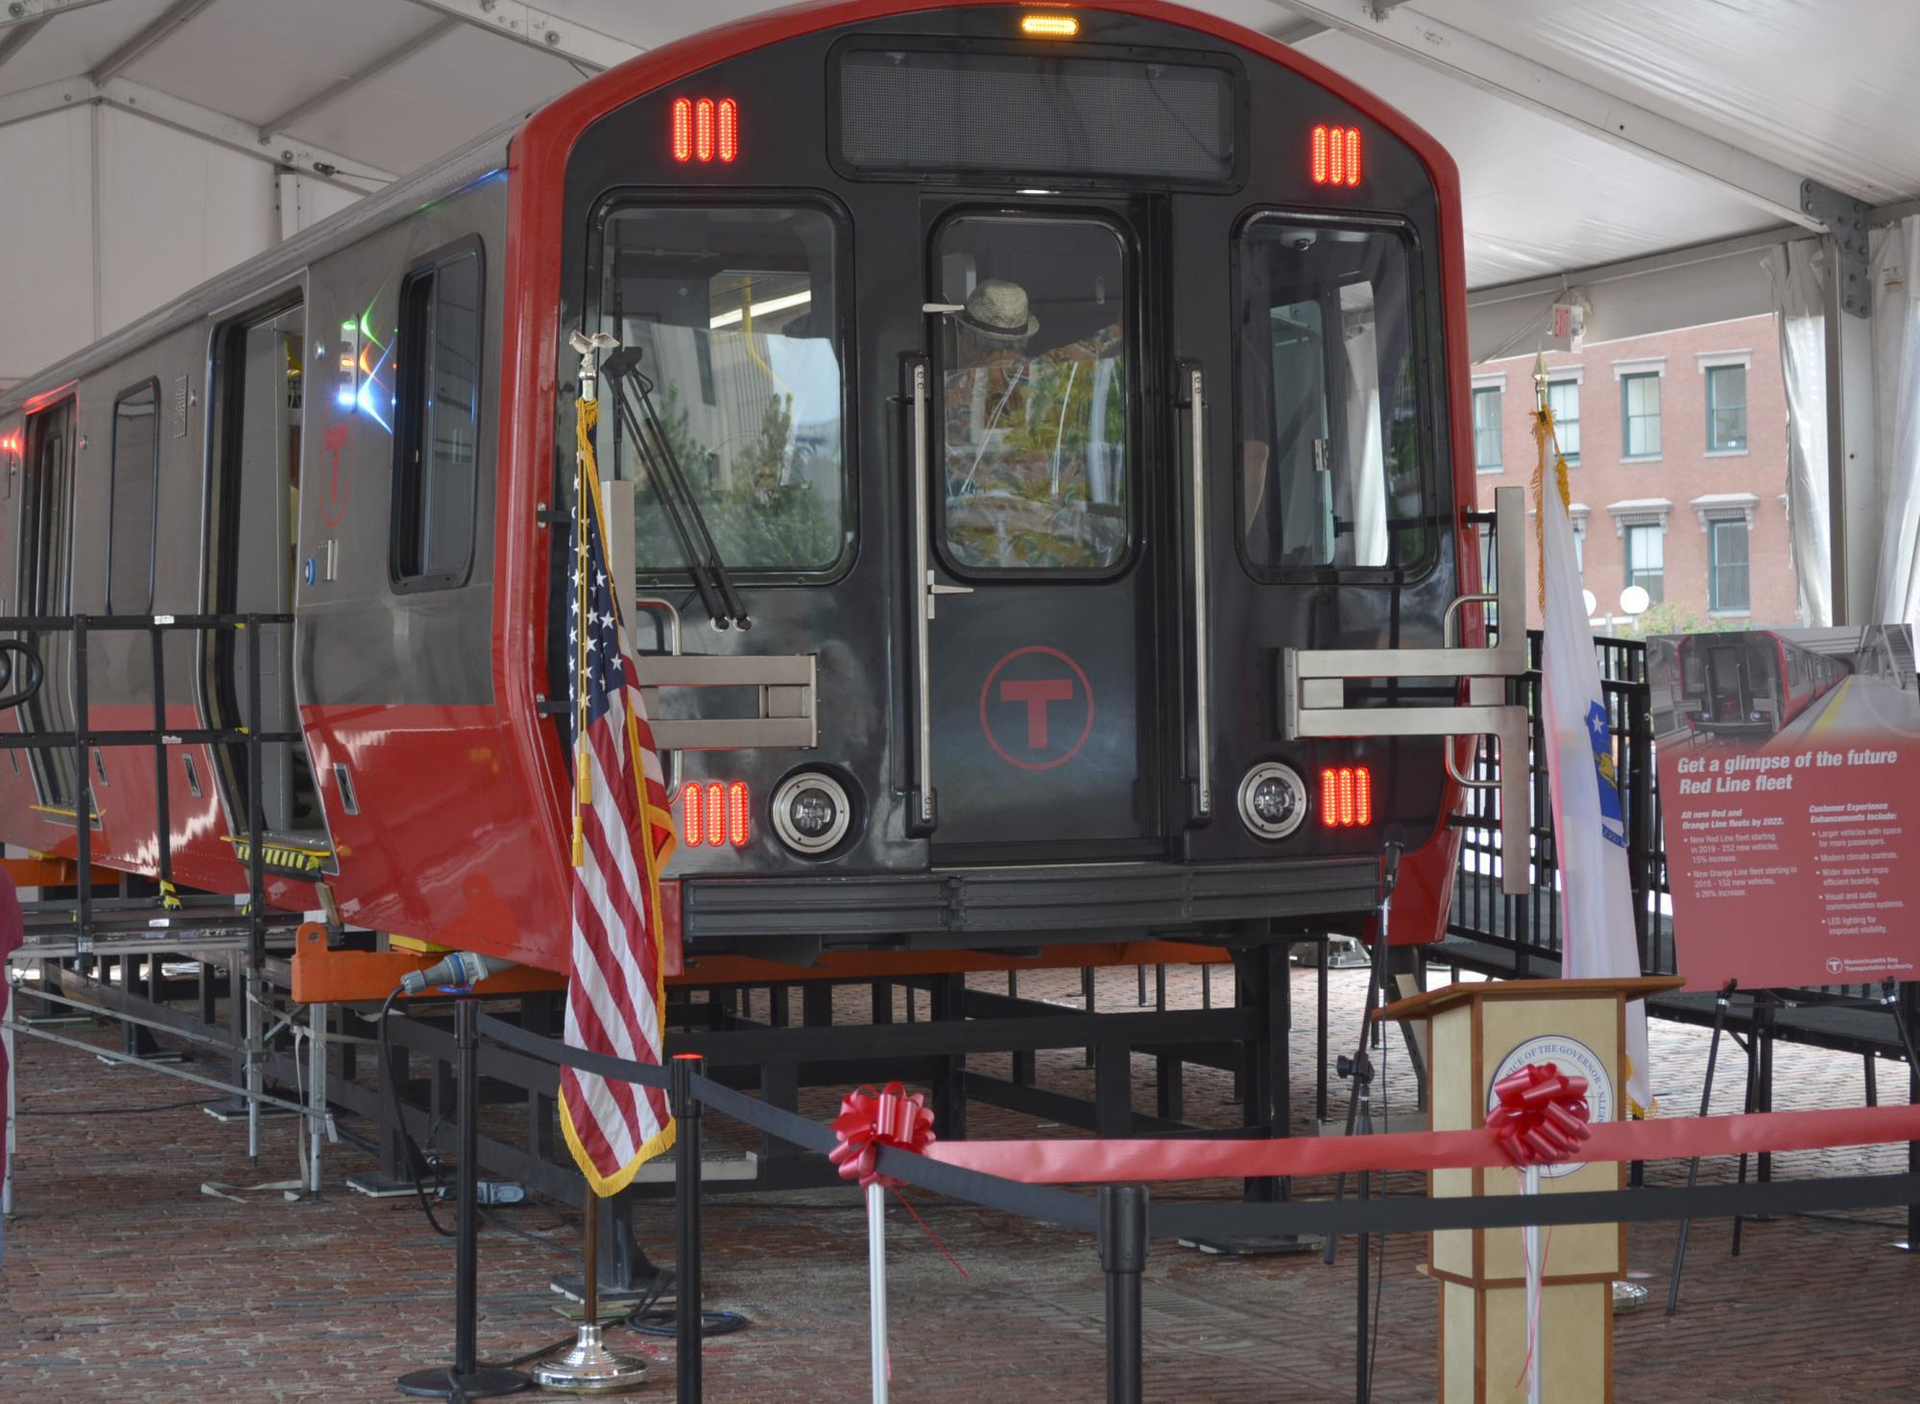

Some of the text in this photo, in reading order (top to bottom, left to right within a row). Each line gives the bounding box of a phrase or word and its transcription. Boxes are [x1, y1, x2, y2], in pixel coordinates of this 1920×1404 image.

[1000, 679, 1073, 749] T
[1678, 750, 1897, 774] Get a glimpse of the future
[1680, 773, 1792, 794] Red Line fleet
[1809, 803, 1888, 813] Customer Experience
[1681, 809, 1742, 819] All new Red and
[1811, 814, 1864, 823] Enhancements
[1683, 818, 1784, 830] Orange Line fleets by 2022.
[1706, 835, 1719, 843] Red
[1735, 833, 1750, 842] fleet
[1751, 833, 1776, 842] starting
[1818, 830, 1839, 838] Larger
[1847, 853, 1870, 861] climate
[1693, 870, 1708, 878] New
[1710, 869, 1733, 878] Orange
[1734, 868, 1748, 876] Line
[1749, 867, 1764, 875] fleet
[1765, 867, 1789, 875] starting
[1824, 878, 1849, 886] efficient
[1859, 891, 1877, 899] audio
[1842, 917, 1866, 925] lighting
[1829, 927, 1859, 935] improved
[1828, 961, 1839, 971] T
[1524, 1047, 1537, 1060] OF
[1538, 1044, 1558, 1055] THE
[1559, 1045, 1602, 1086] GOVERNOR
